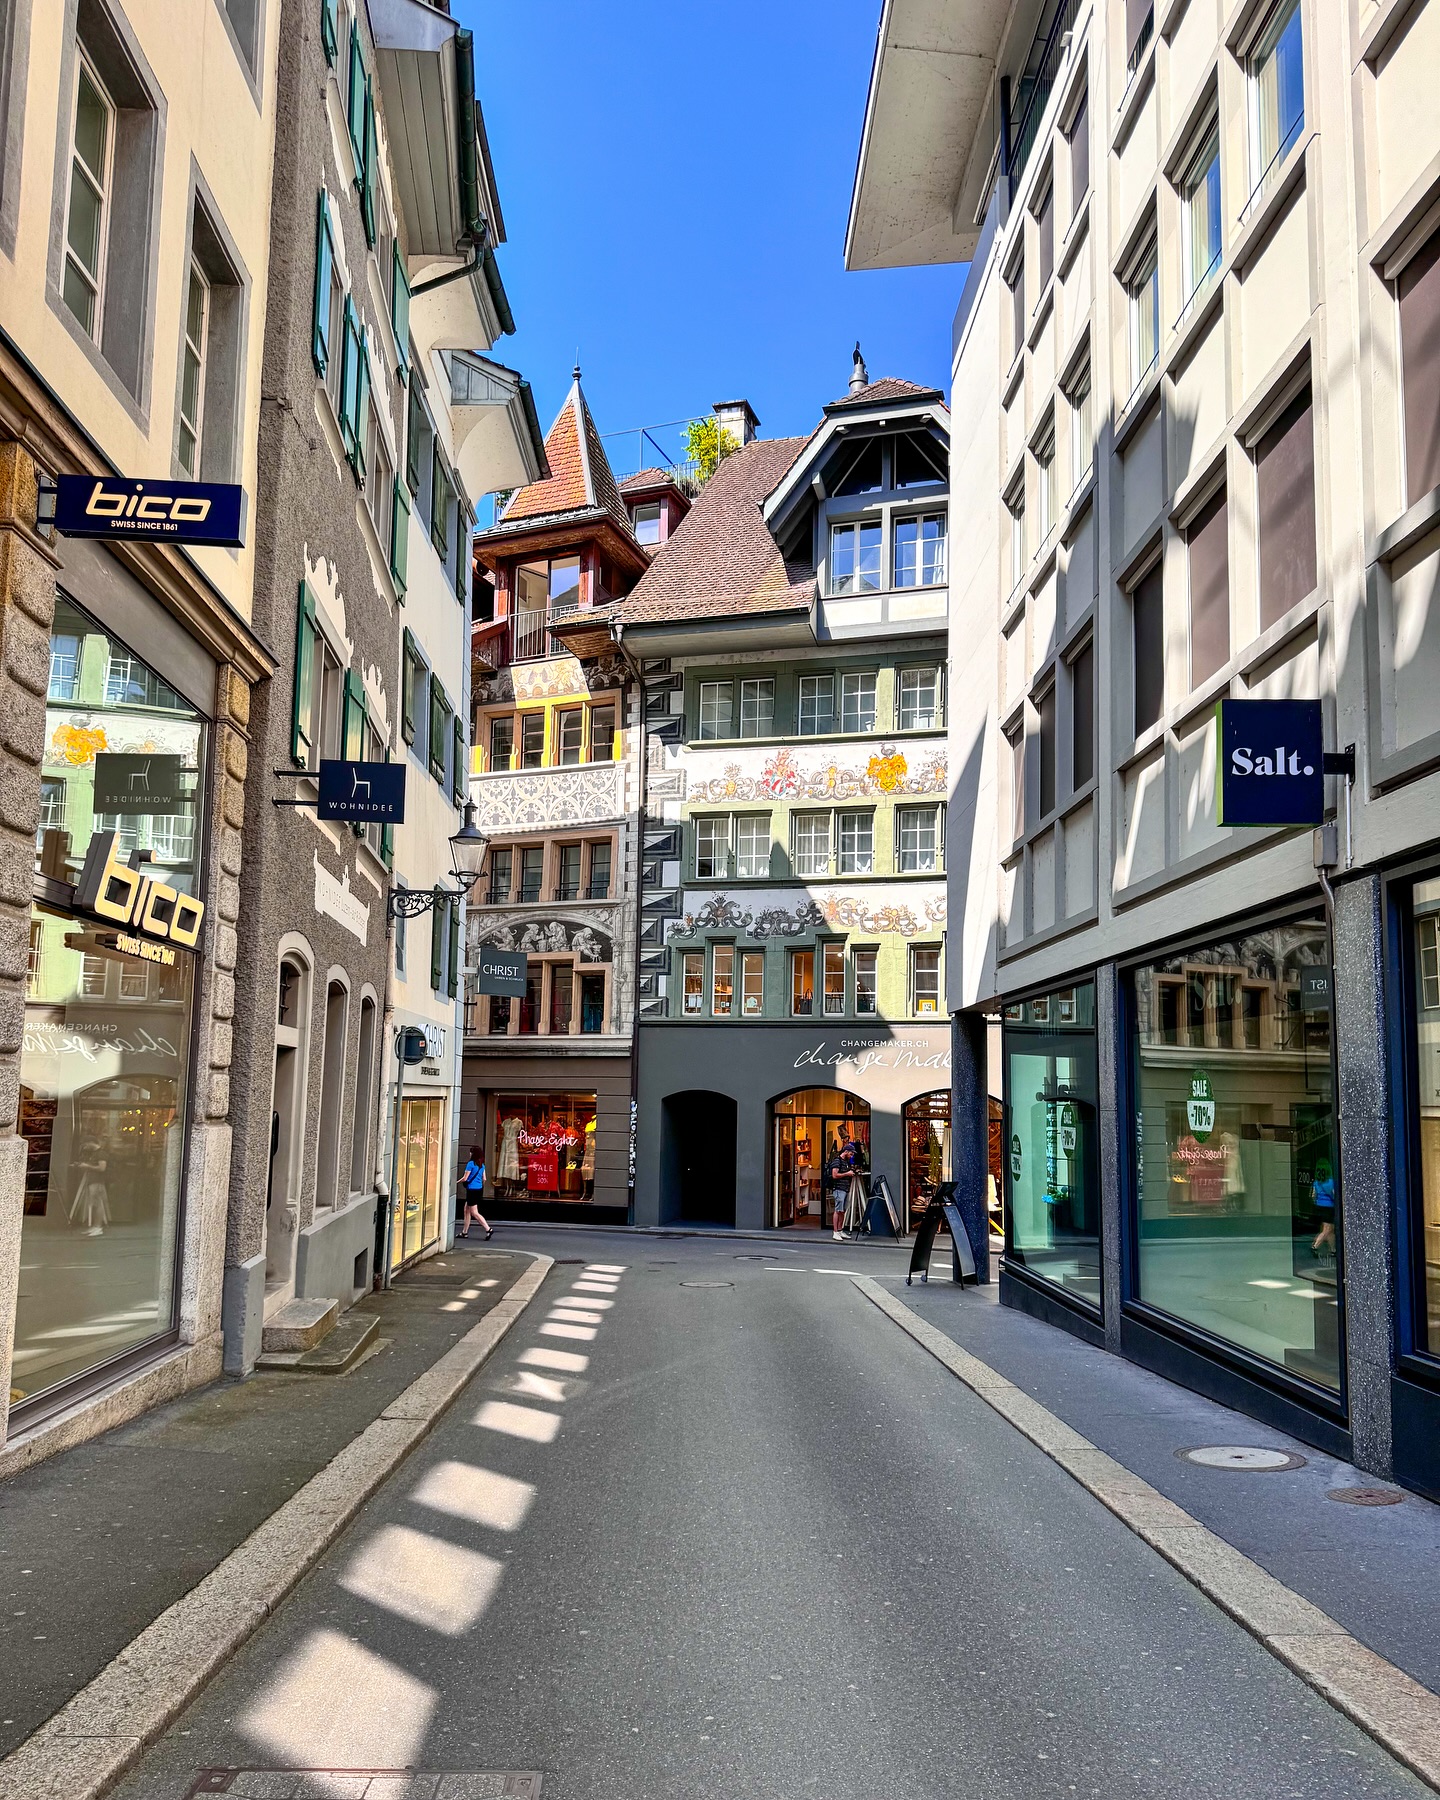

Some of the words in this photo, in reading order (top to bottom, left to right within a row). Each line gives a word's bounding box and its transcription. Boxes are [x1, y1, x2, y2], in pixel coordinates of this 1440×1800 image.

[86, 482, 211, 521] bico
[111, 520, 136, 529] SWISS
[137, 521, 162, 530] SINCE
[163, 523, 178, 531] 1861
[1231, 746, 1315, 776] Salt.
[329, 801, 393, 812] WOHNIDEE
[94, 831, 205, 947] bico
[116, 933, 141, 956] SWISS
[140, 941, 161, 963] SINCE
[482, 963, 519, 977] CHRIST
[1193, 964, 1242, 1011] Salt.
[841, 1040, 929, 1048] CHANGEMAKER.CH
[1192, 1079, 1208, 1097] SALE
[1191, 1105, 1211, 1126] -70%
[517, 1129, 548, 1147] Phase
[548, 1133, 578, 1151] Eight
[533, 1162, 553, 1172] SALE
